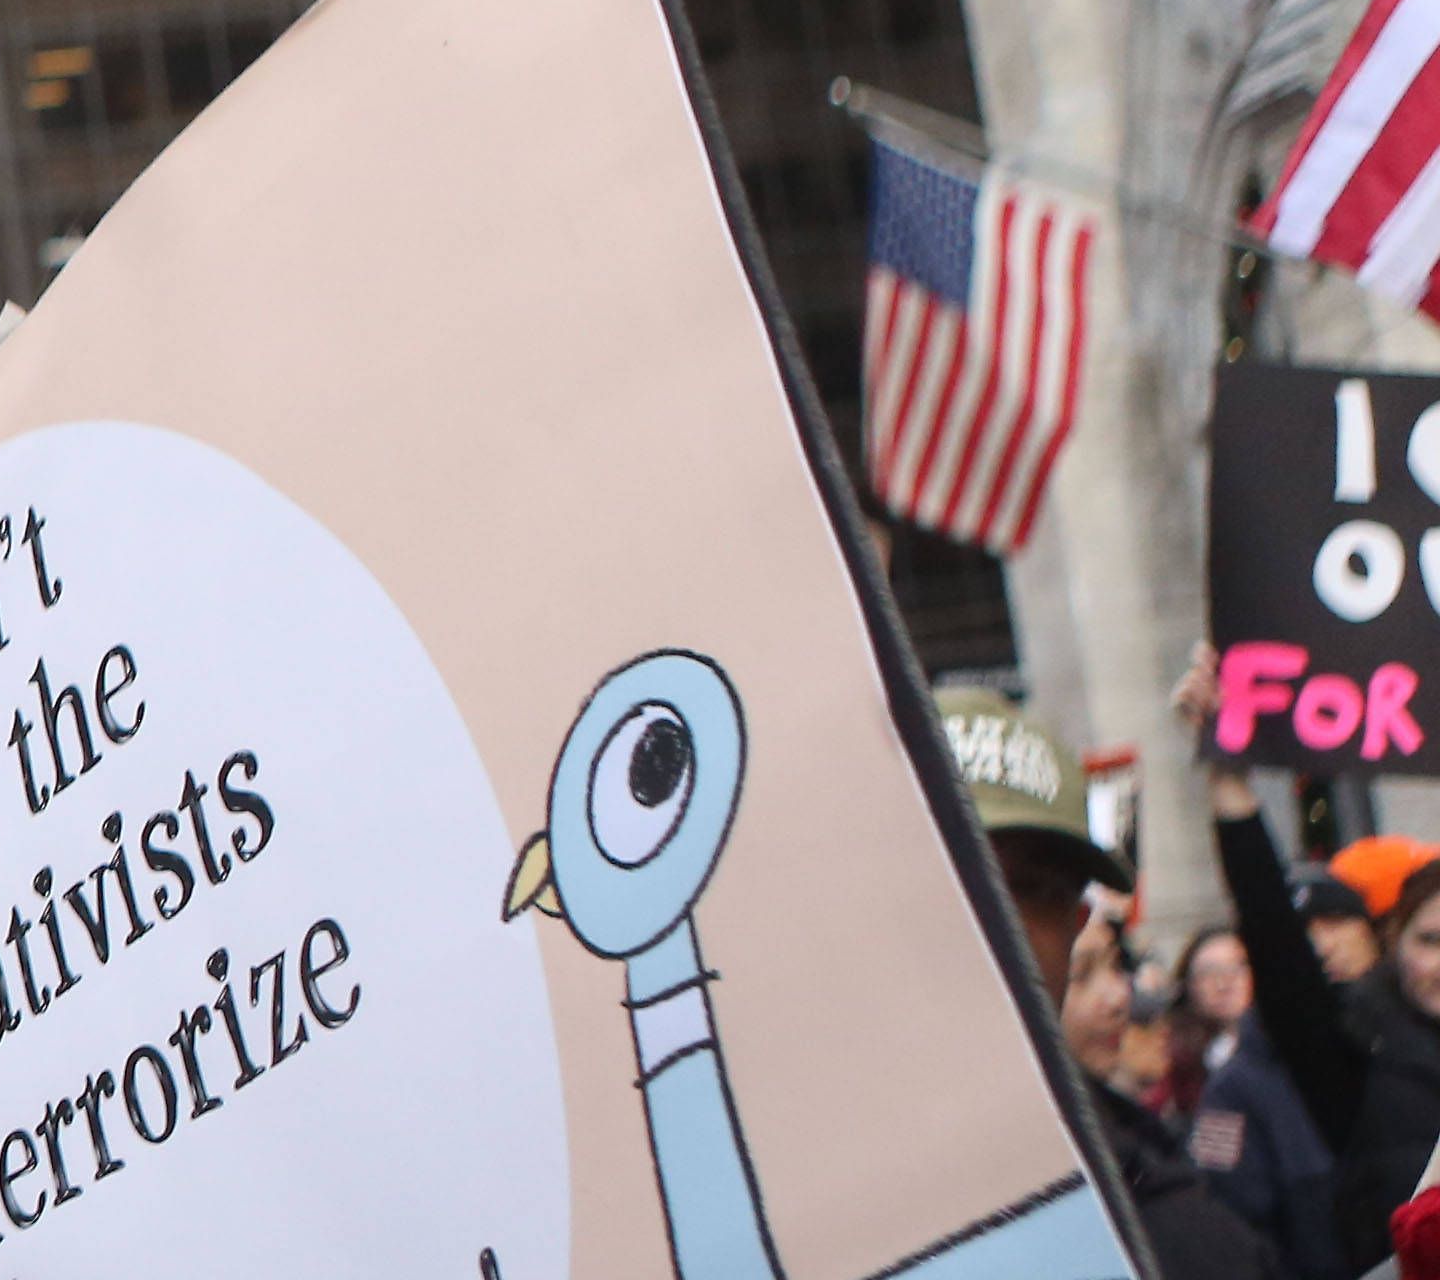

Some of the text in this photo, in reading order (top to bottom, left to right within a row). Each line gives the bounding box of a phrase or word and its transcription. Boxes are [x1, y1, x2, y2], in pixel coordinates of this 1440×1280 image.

[1313, 520, 1440, 622] O
[10, 644, 146, 815] the
[1215, 640, 1425, 761] FOR
